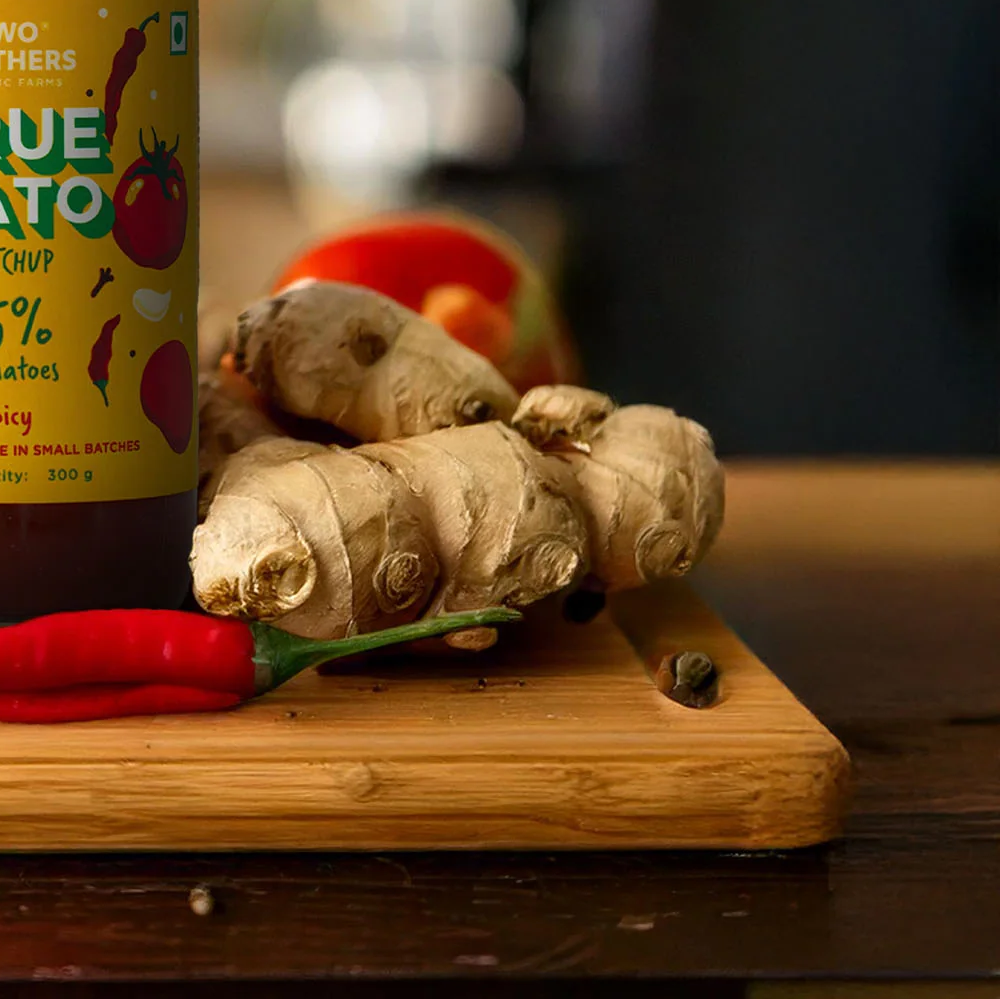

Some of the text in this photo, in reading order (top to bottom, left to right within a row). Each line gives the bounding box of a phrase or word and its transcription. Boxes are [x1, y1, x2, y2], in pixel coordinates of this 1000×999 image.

[18, 78, 63, 88] FARMS
[13, 445, 27, 457] IN
[33, 443, 81, 456] SMALL
[84, 439, 141, 455] BATCHES
[47, 468, 79, 482] 300
[83, 471, 94, 483] g
